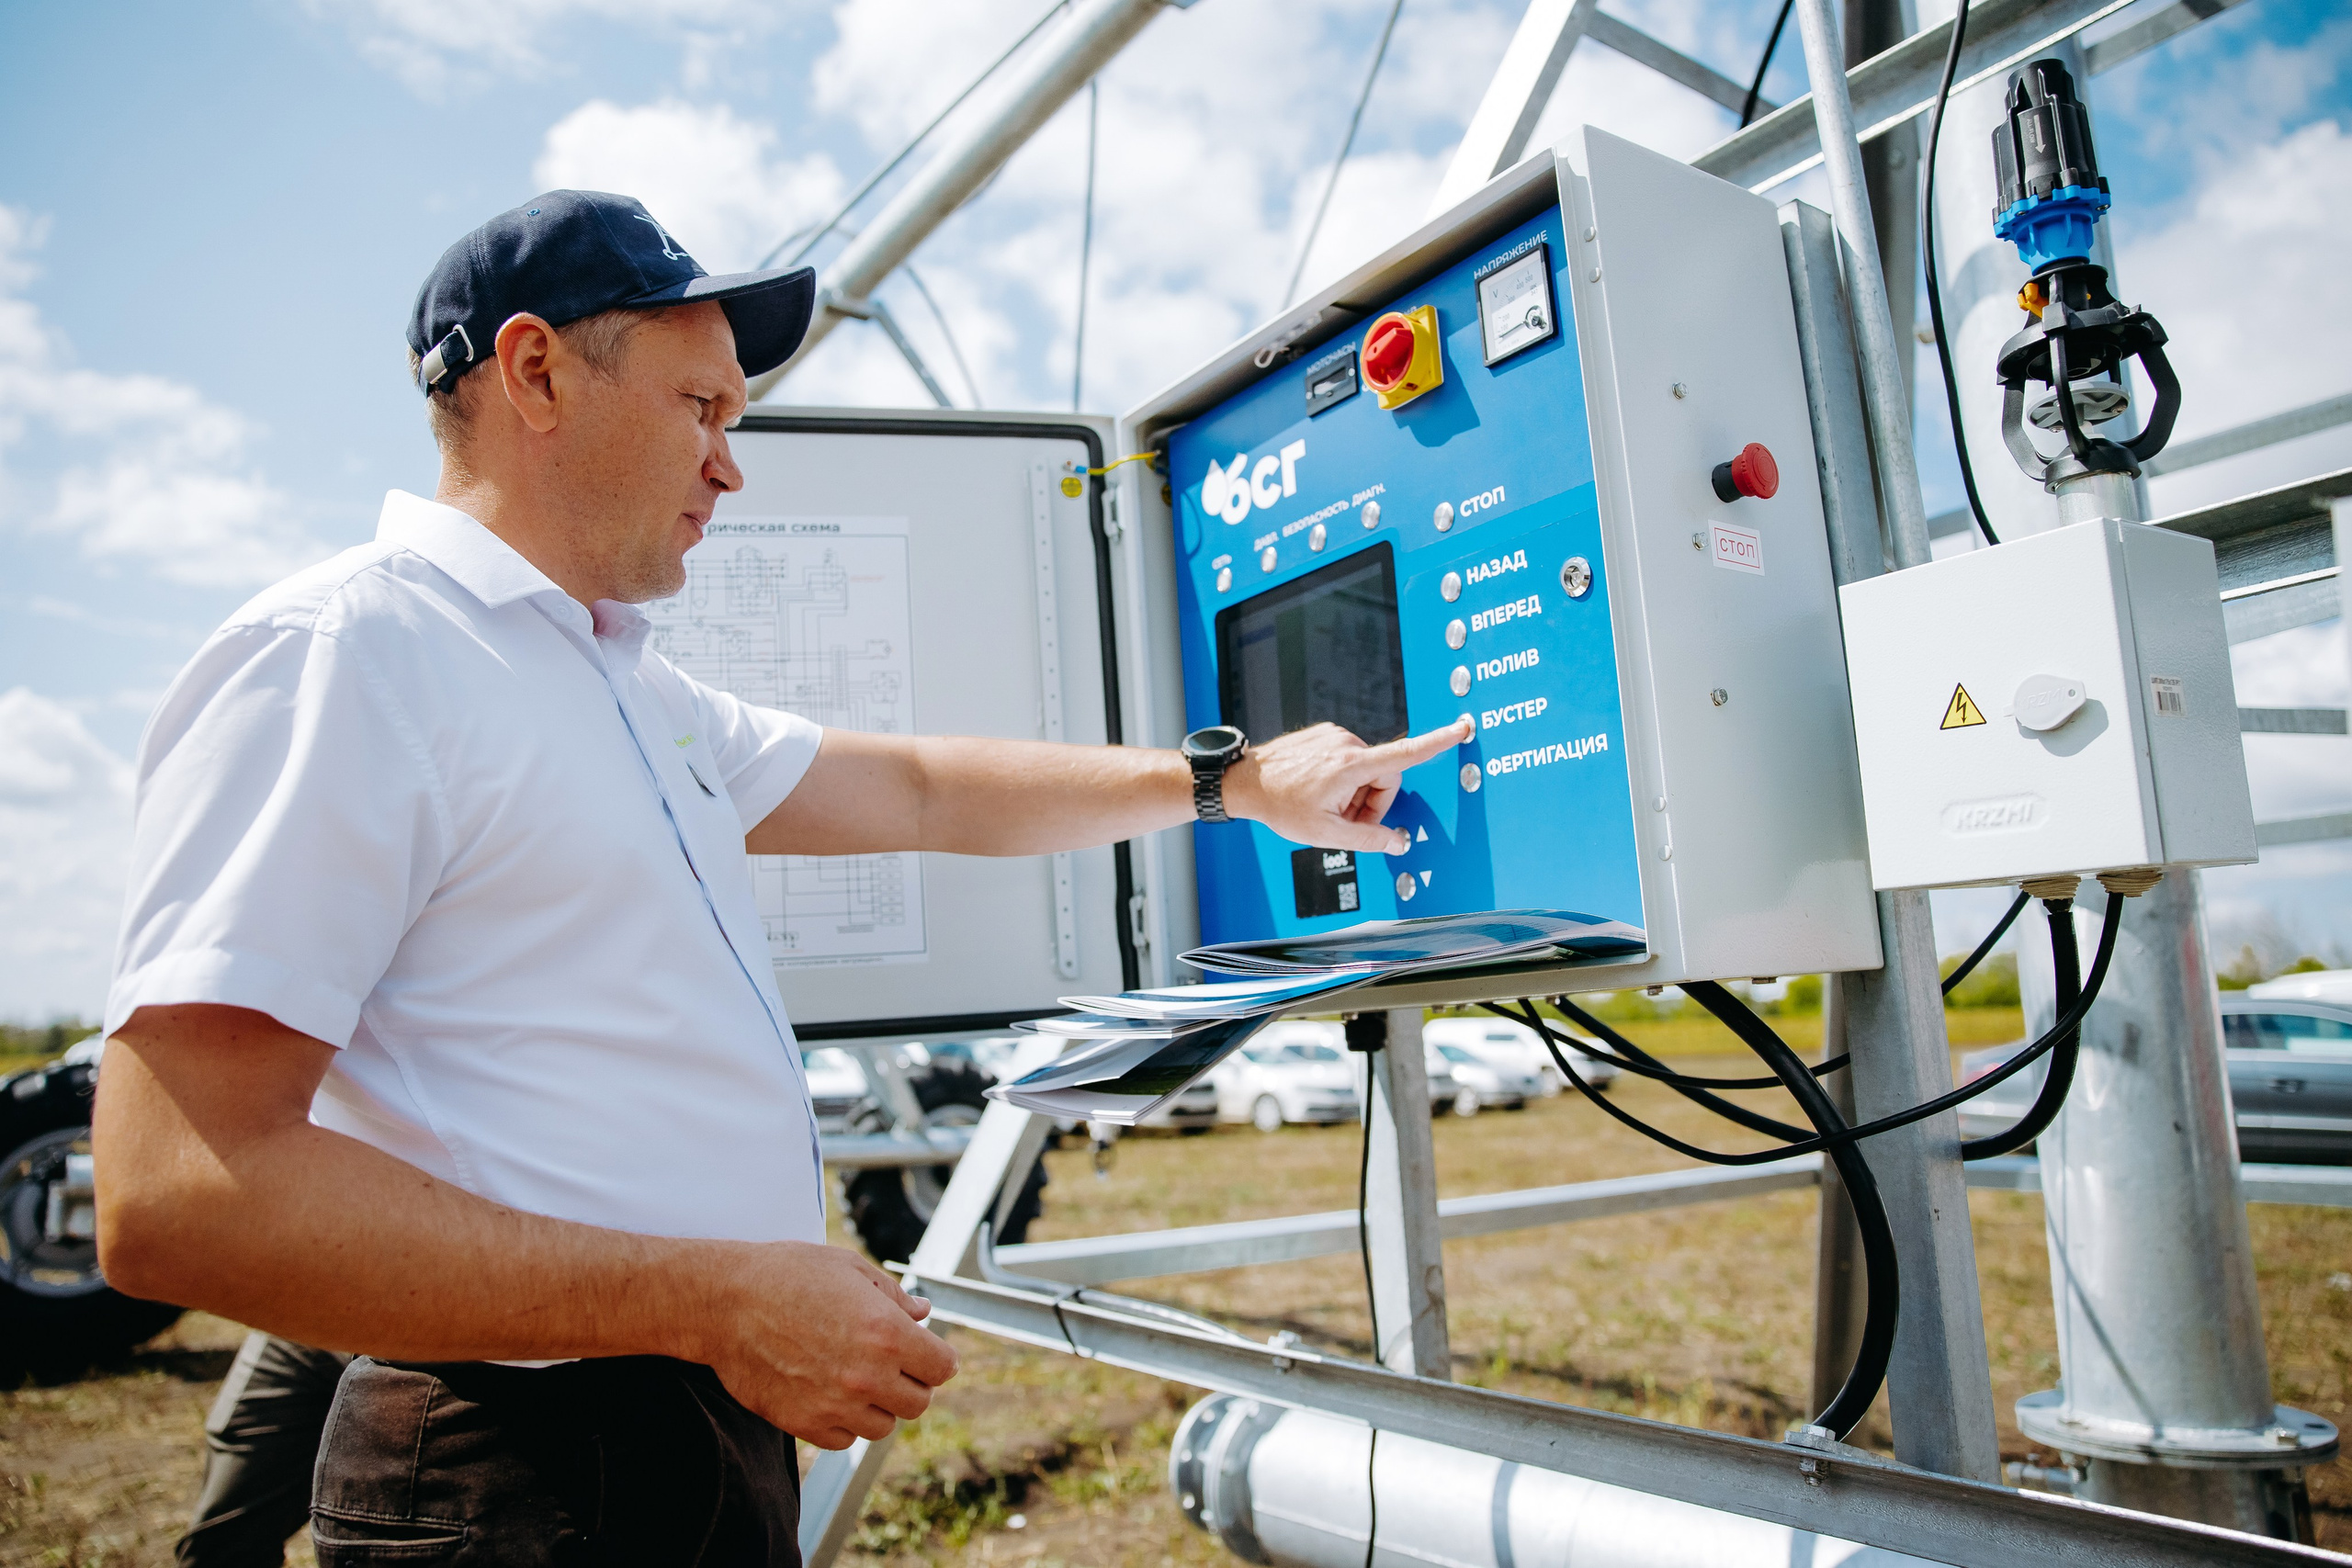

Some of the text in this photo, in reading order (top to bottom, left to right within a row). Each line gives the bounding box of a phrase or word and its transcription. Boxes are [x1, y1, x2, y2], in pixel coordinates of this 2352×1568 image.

[1474, 230, 1548, 279] НАПРЯЖЕНИЕ
[1492, 288, 1498, 299] V
[1351, 482, 1386, 507] ДИАГН.
[1459, 485, 1506, 517] СТОП
[707, 523, 841, 536] рическая схема
[1282, 500, 1350, 537] БЕЗОПАСНОСТЬ
[1719, 537, 1755, 558] СТОП
[1465, 548, 1528, 585] НАЗАД
[1471, 594, 1542, 633] ВПЕРЕД
[1476, 648, 1540, 682] ПОЛИВ
[1481, 696, 1548, 730] БУСТЕР
[1486, 733, 1609, 777] ФЕРТИГАЦИЯ
[1957, 801, 2034, 829] KRZMI
